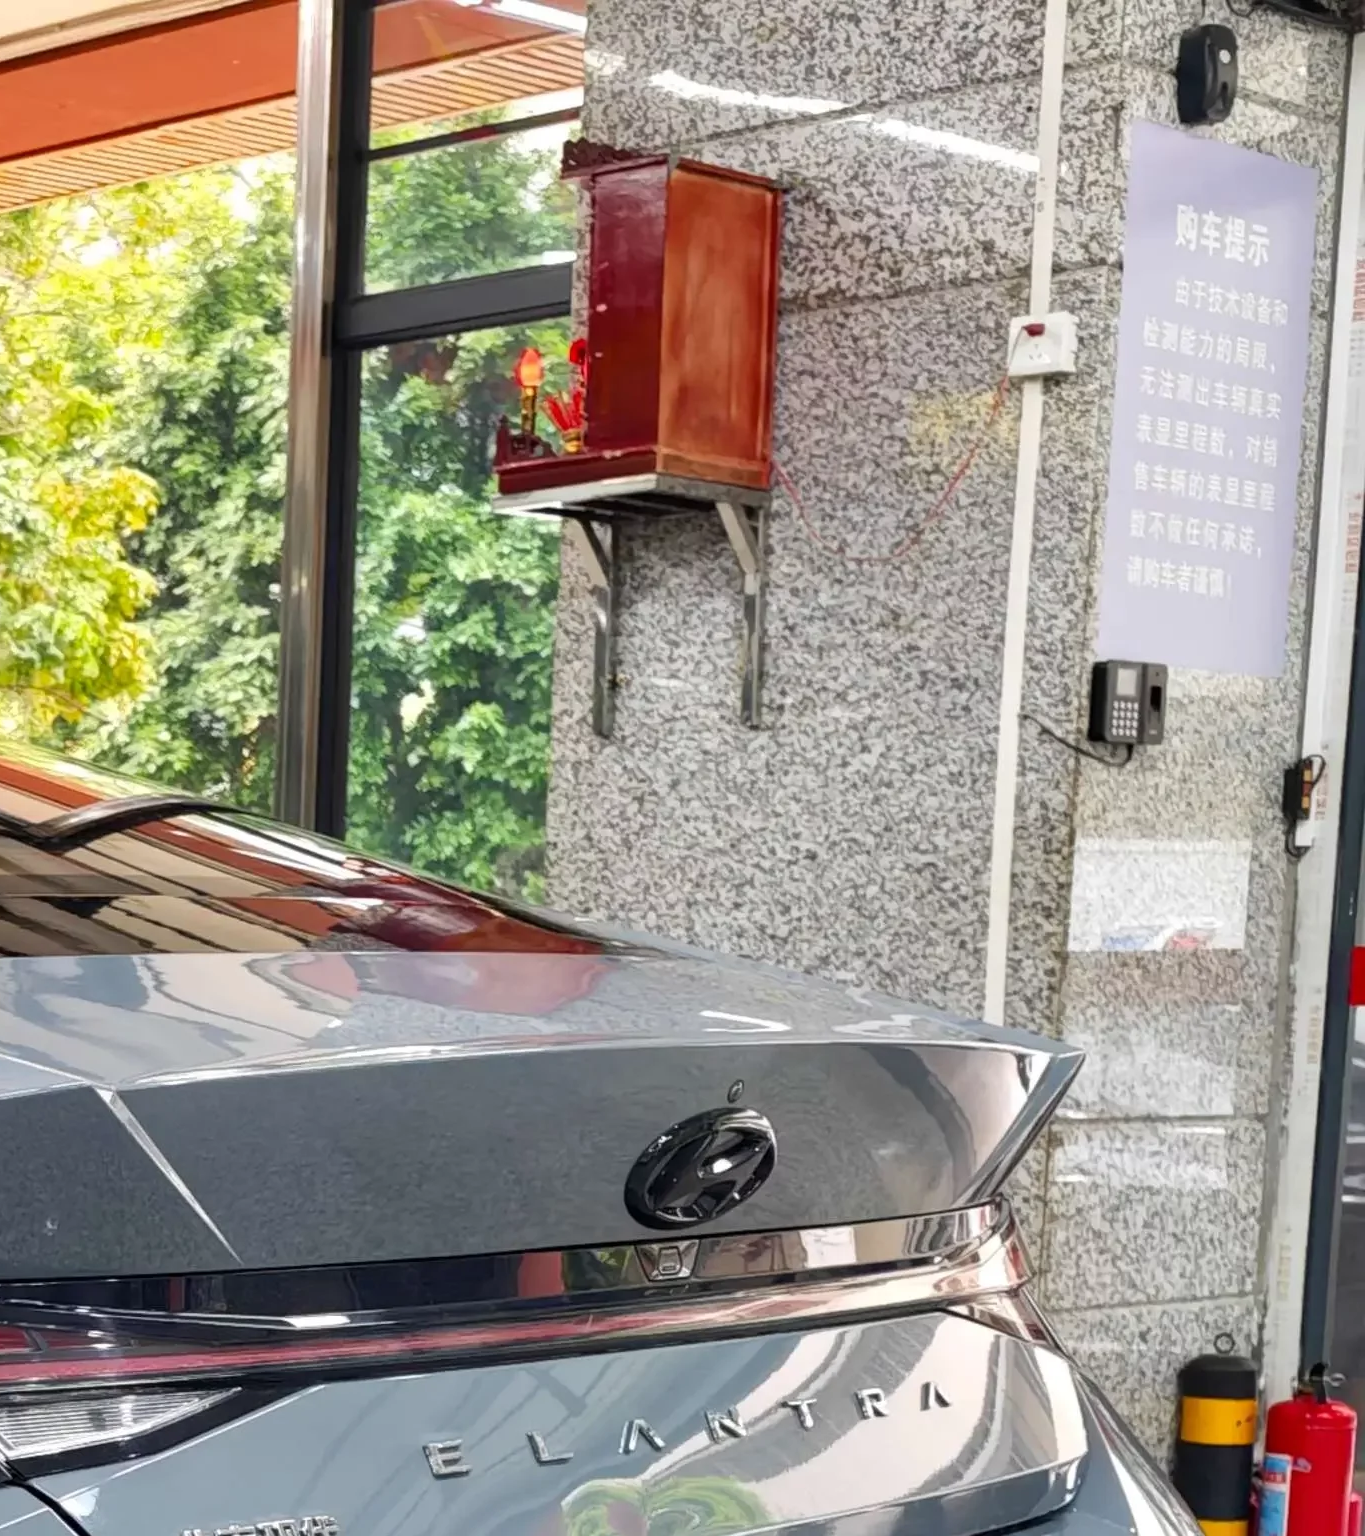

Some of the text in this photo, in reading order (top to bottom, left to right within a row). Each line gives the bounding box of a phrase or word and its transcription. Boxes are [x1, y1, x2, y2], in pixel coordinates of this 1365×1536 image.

[1175, 204, 1270, 267] 购车提示
[1175, 276, 1288, 327] 由于技术设备和
[422, 1381, 951, 1480] ELANTRA
